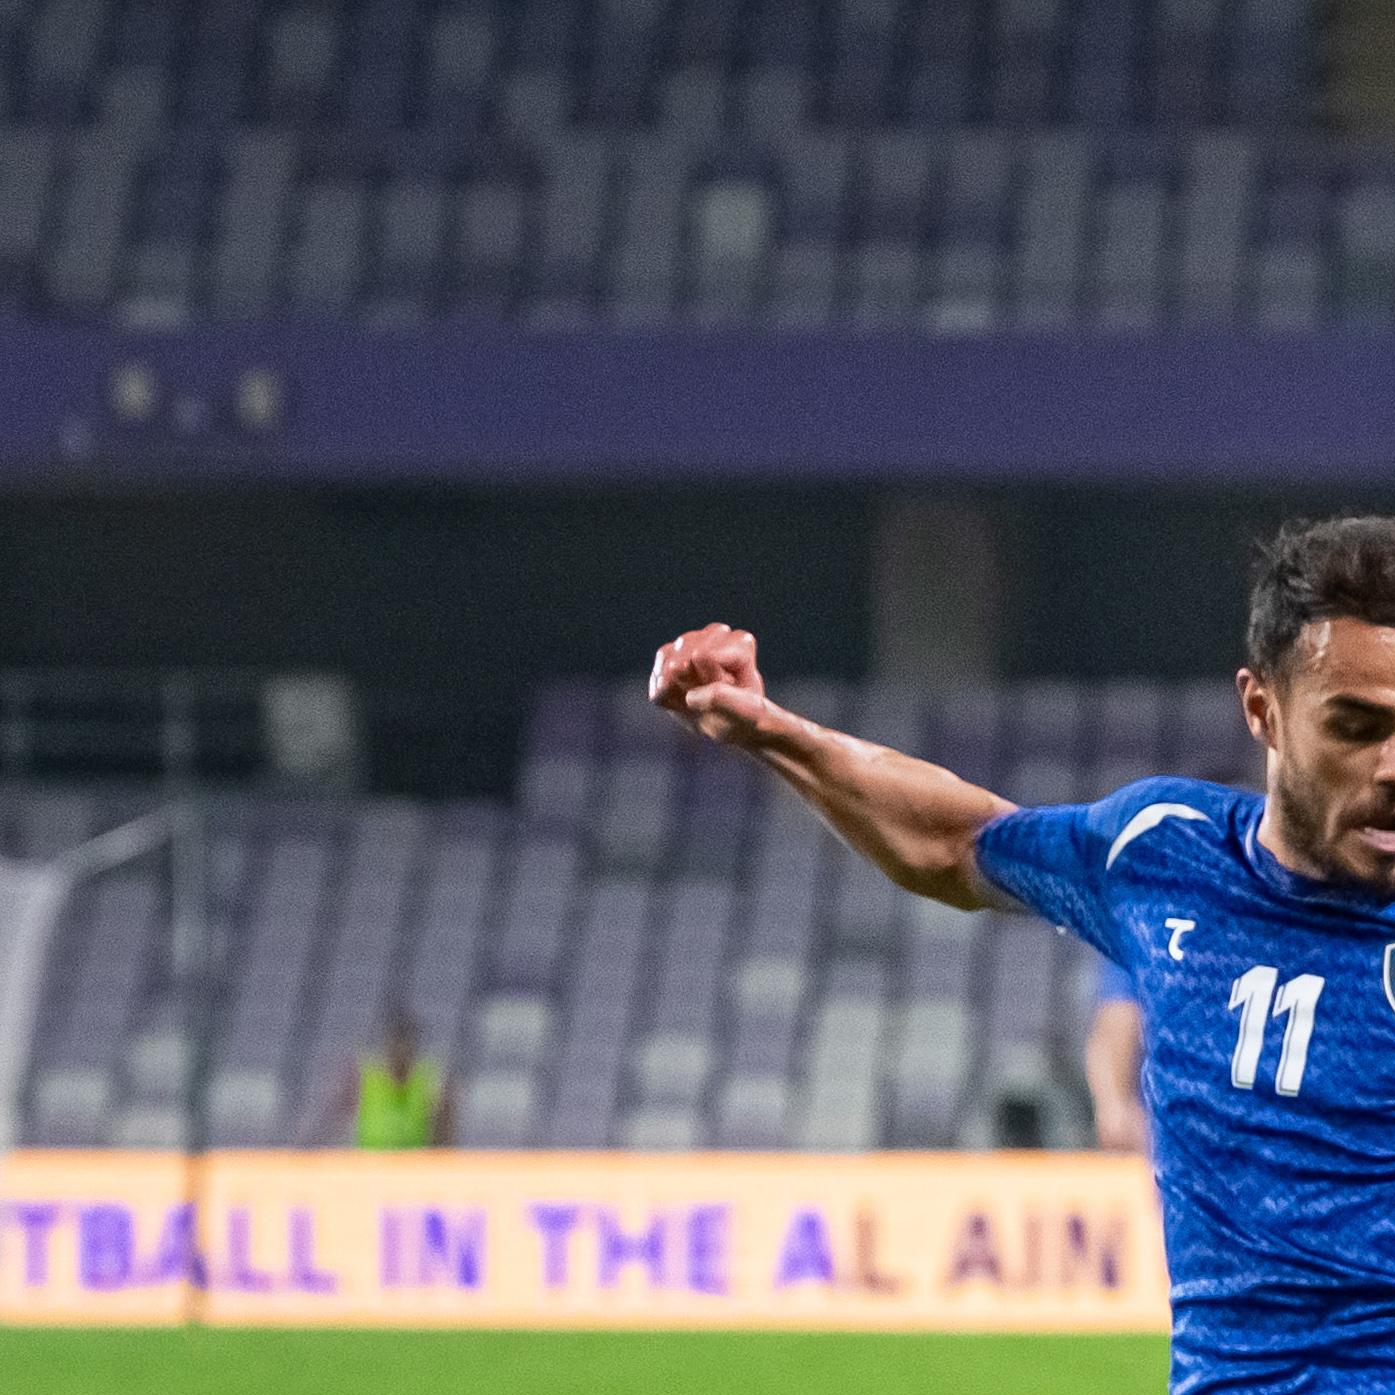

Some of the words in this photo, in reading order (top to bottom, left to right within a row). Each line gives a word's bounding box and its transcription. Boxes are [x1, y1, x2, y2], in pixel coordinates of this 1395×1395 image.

[1227, 964, 1326, 1098] 11
[378, 1207, 487, 1290] IN
[530, 1205, 730, 1295] THE
[945, 1209, 1128, 1297] AIN
